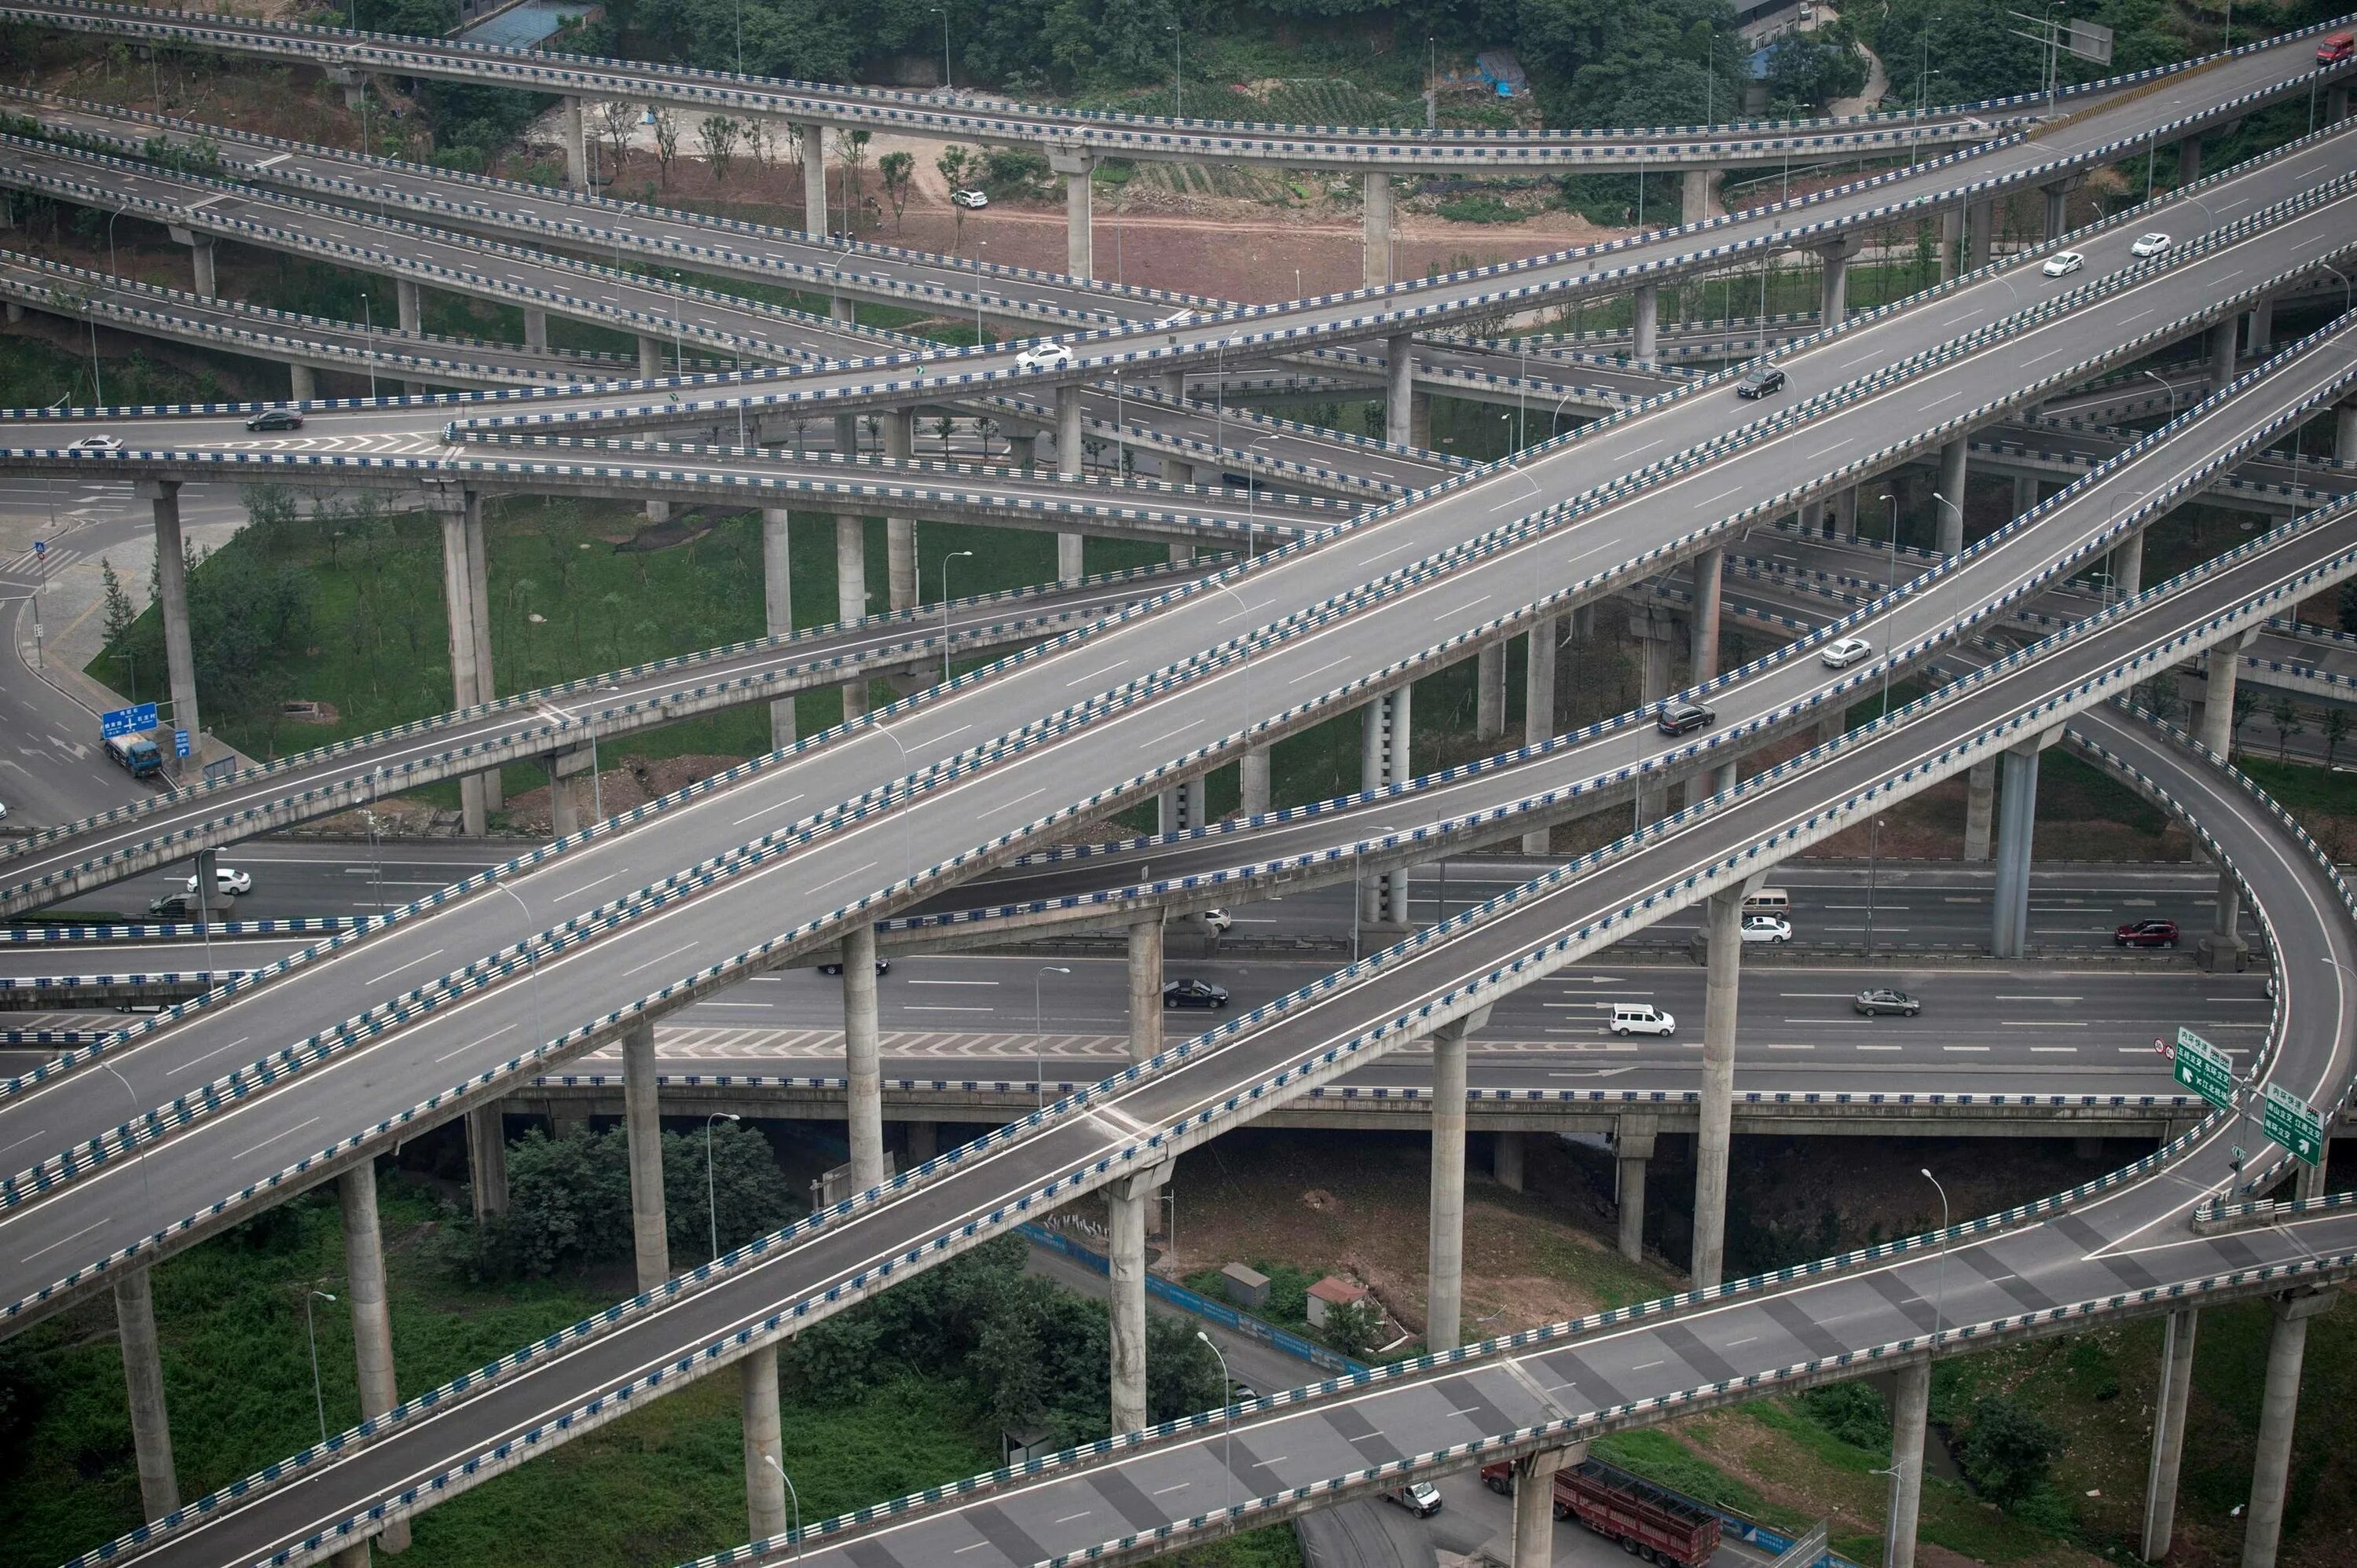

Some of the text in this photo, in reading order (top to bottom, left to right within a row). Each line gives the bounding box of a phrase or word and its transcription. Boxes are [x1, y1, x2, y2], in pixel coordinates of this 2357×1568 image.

[2181, 1030, 2207, 1052] 内环快速
[2177, 1046, 2202, 1068] 五桂立交
[2204, 1061, 2228, 1083] 东环立交
[2201, 1079, 2227, 1101] 江北机场
[2273, 1086, 2301, 1109] 内环快速
[2264, 1118, 2290, 1140] 南环立交
[2267, 1101, 2293, 1123] 南山立交
[2294, 1117, 2320, 1140] 江南立交
